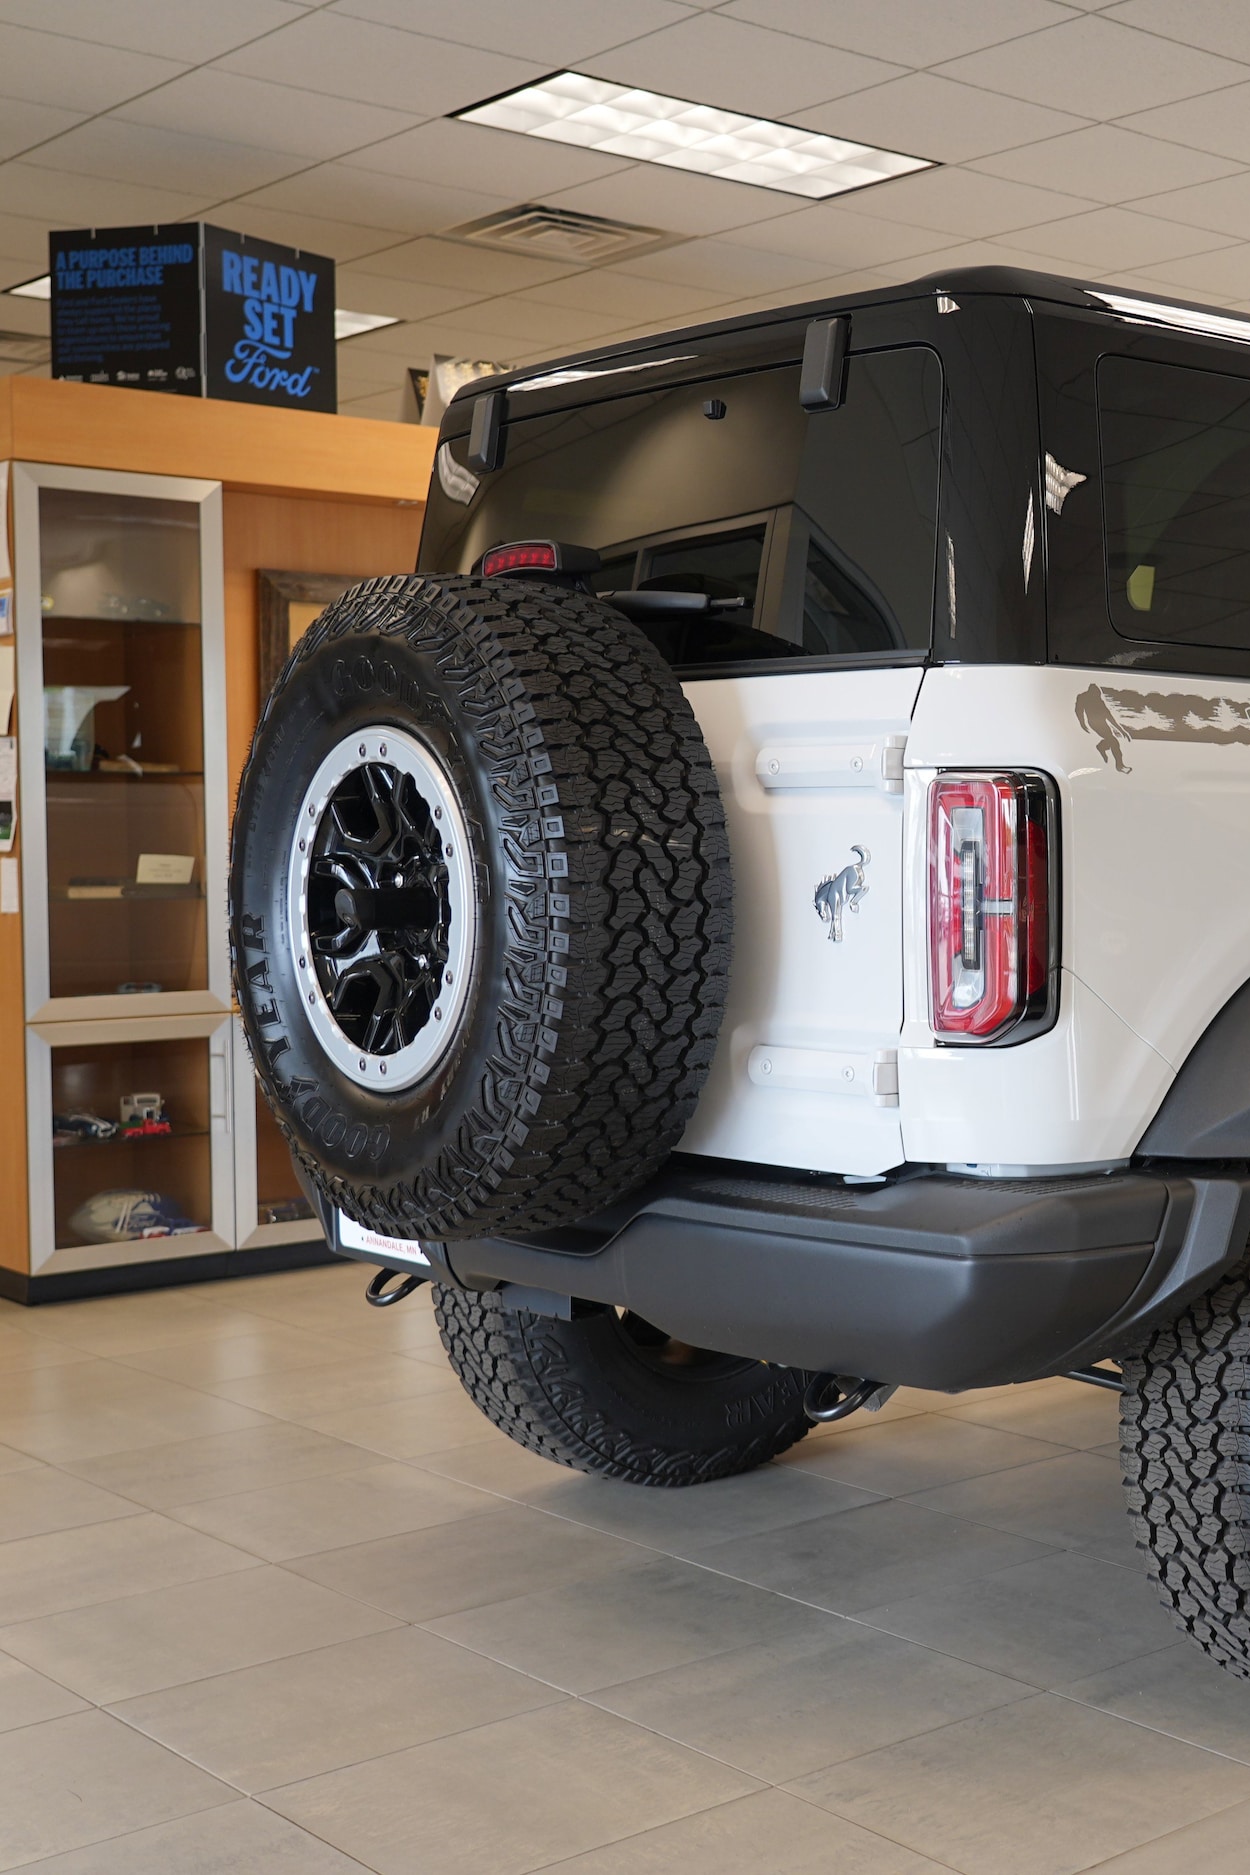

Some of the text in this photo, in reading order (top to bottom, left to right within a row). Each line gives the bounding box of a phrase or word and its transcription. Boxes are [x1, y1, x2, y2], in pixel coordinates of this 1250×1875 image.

[56, 243, 193, 270] A PURPOSE BEHIND
[57, 265, 164, 291] THE PURCHASE
[222, 250, 317, 313] READY
[243, 299, 297, 348] SET
[225, 340, 313, 397] Ford
[406, 1245, 417, 1255] MN
